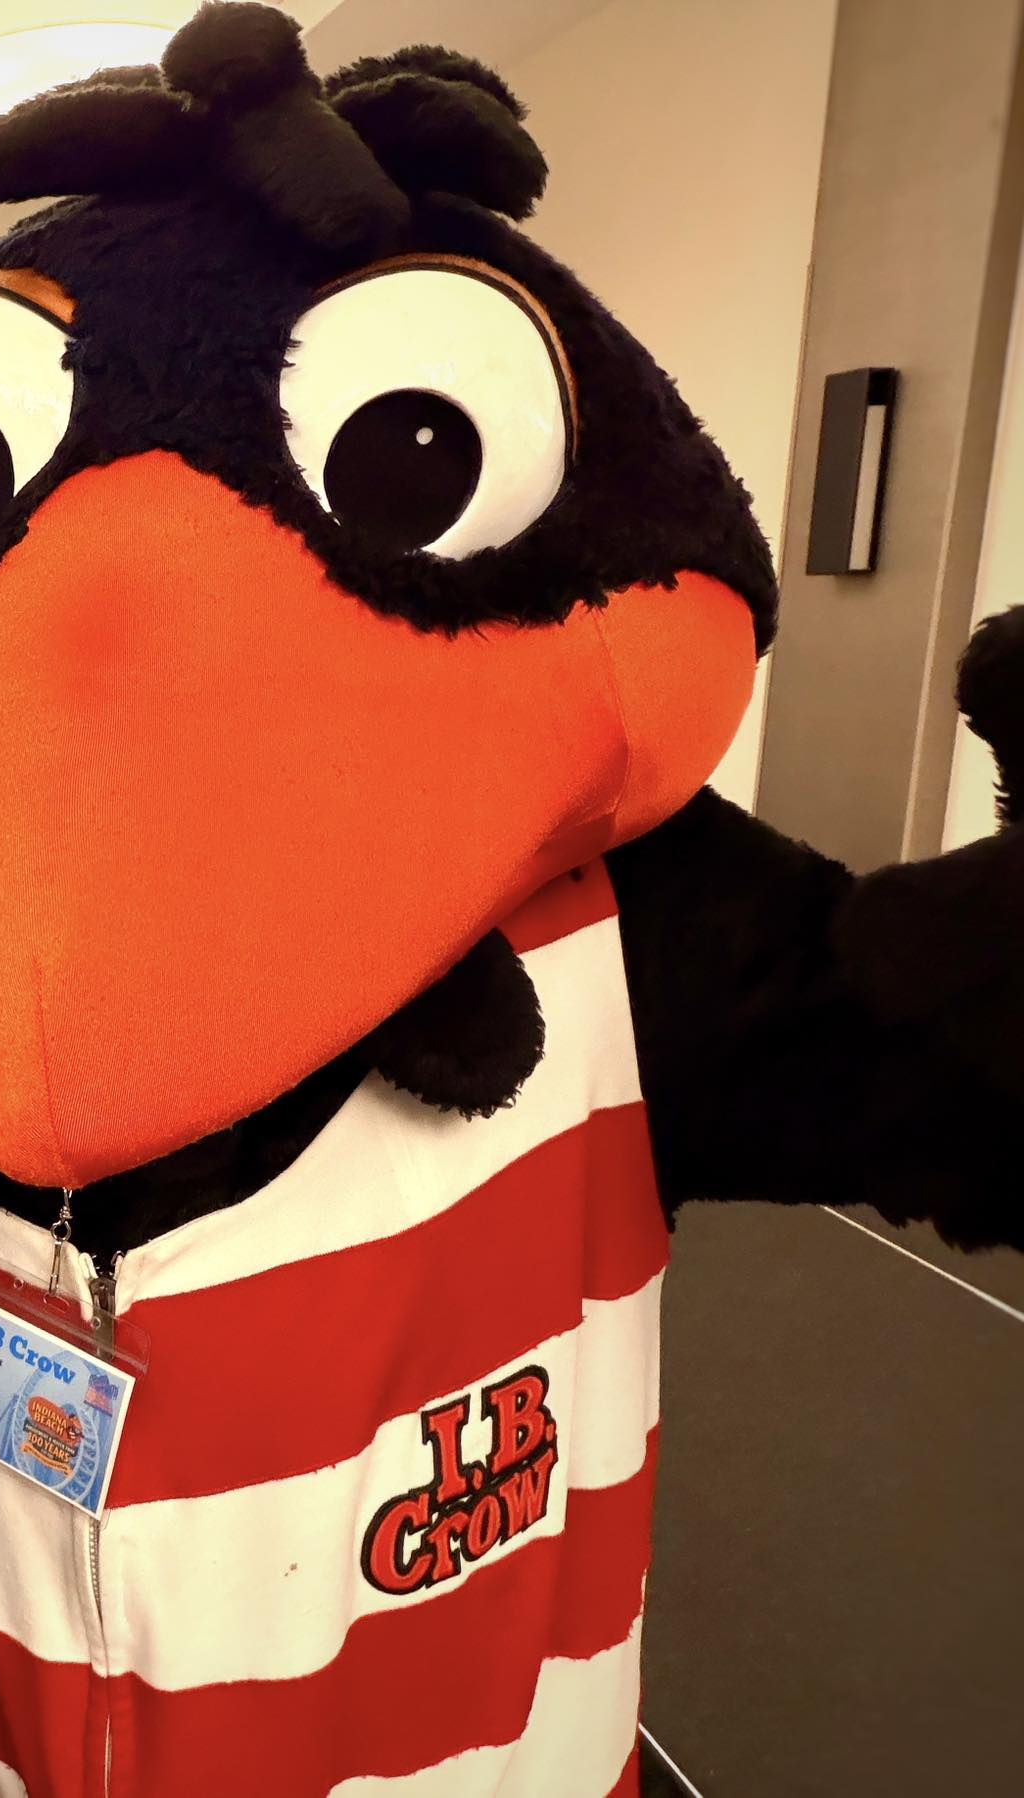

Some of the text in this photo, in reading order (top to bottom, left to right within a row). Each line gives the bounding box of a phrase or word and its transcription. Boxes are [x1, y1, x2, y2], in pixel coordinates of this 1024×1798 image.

[9, 1335, 76, 1384] Crow
[31, 1401, 67, 1429] INDIANA
[34, 1412, 64, 1436] BEACH
[28, 1431, 43, 1447] 100
[43, 1441, 71, 1462] YEARS
[421, 1364, 558, 1507] I.B.
[360, 1448, 558, 1595] Crow
